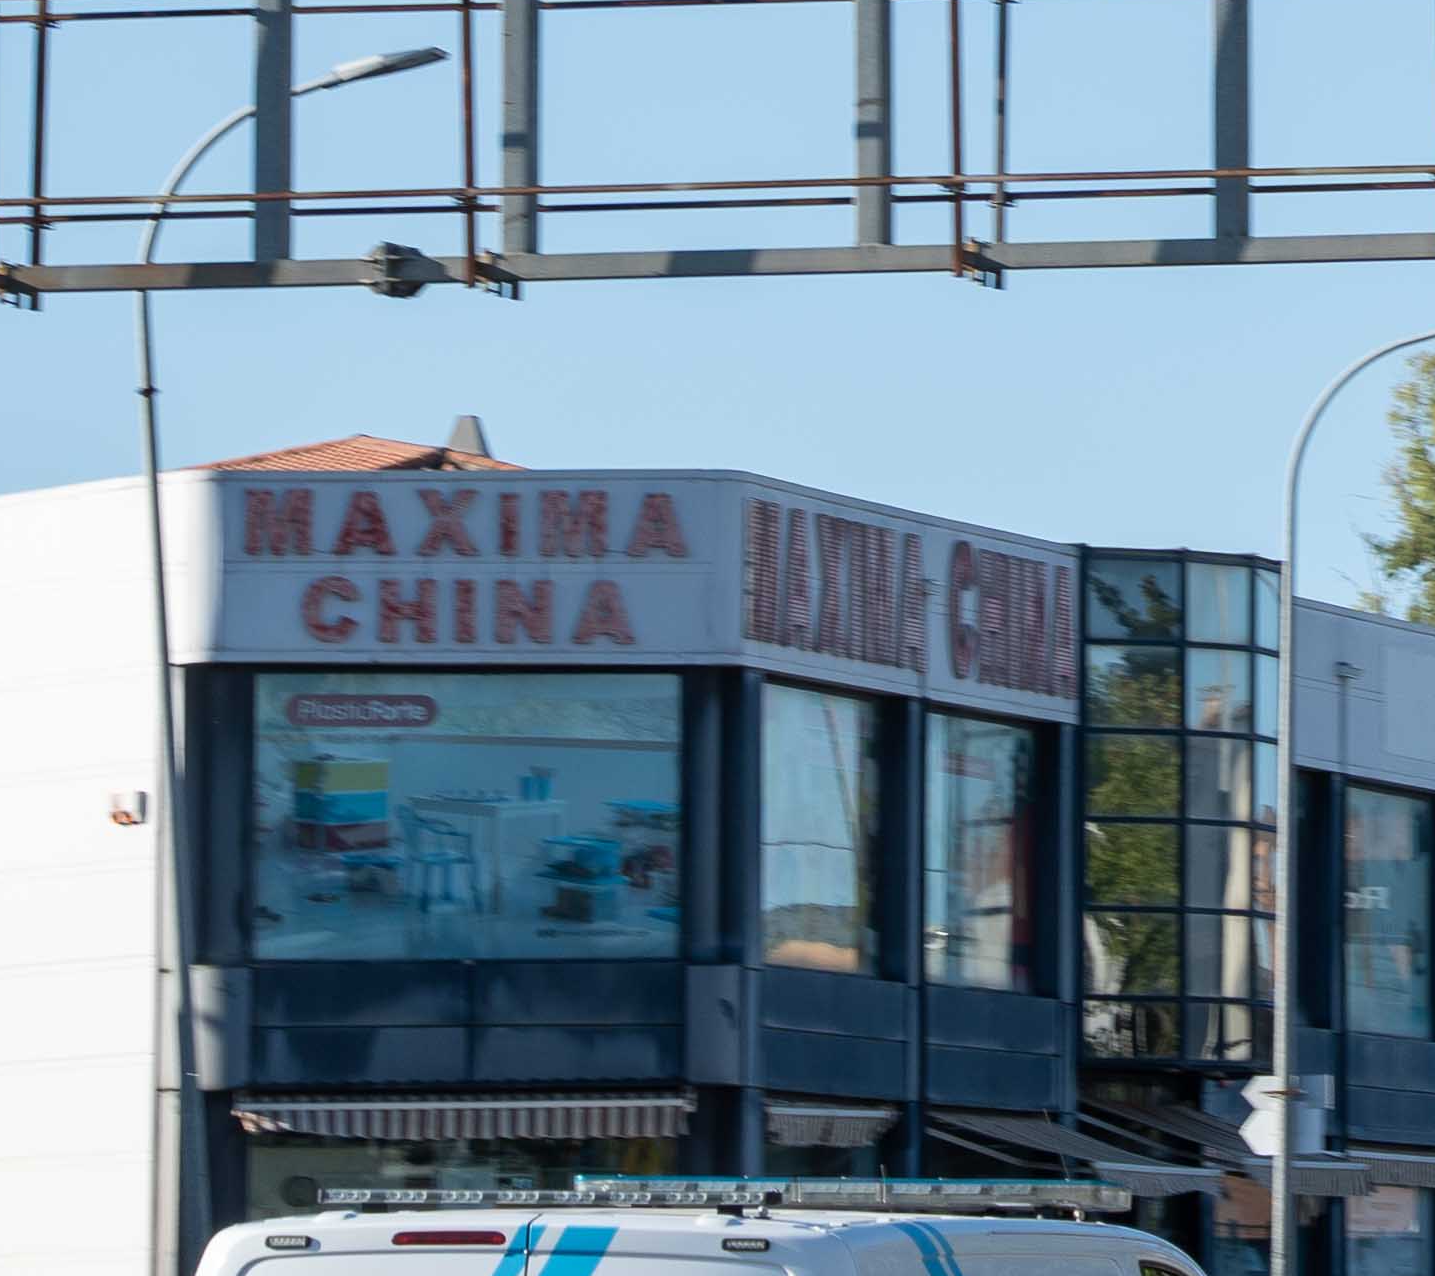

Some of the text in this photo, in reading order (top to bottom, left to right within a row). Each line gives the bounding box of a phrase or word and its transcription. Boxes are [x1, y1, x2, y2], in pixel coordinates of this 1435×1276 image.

[244, 488, 689, 558] MAXIMA
[301, 575, 637, 645] CHINA
[743, 498, 1079, 700] MAXIMA CHINA
